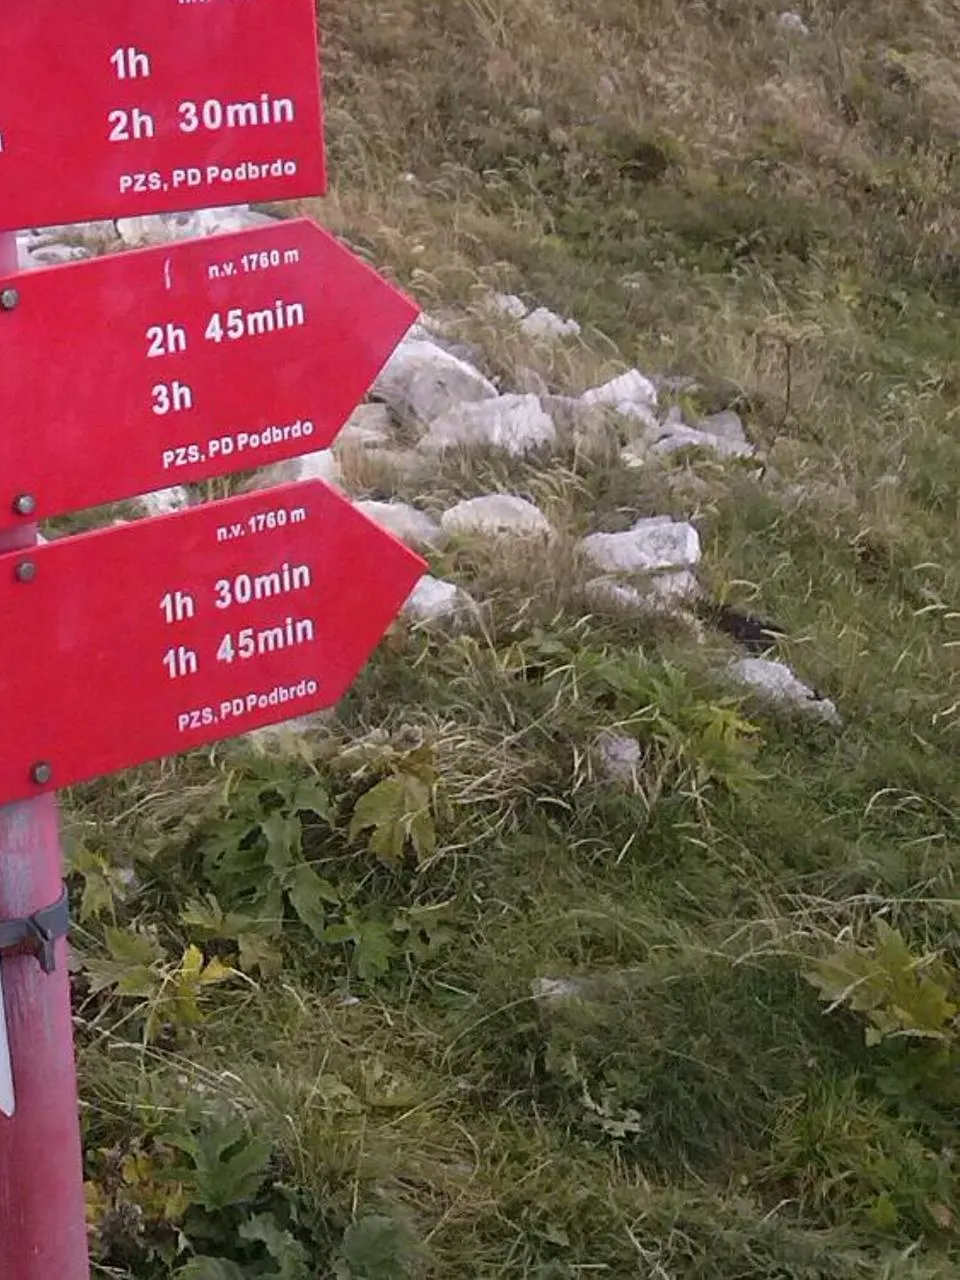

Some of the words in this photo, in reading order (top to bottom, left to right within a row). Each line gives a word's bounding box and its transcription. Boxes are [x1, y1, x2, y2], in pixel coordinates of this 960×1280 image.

[110, 47, 150, 80] 1h
[108, 107, 154, 142] 2h
[178, 93, 294, 133] 30min
[172, 167, 202, 188] PD
[206, 158, 297, 184] Podbrdo
[208, 261, 238, 280] n.v.
[240, 251, 280, 272] 1760
[283, 248, 300, 264] m
[145, 323, 187, 358] 2h
[204, 300, 304, 343] 45min
[151, 380, 192, 415] 3h
[208, 436, 234, 458] PD
[236, 419, 314, 451] Podbrdo
[216, 523, 246, 542] n.v.
[247, 511, 287, 533] 1760
[290, 507, 306, 523] m
[159, 591, 194, 623] 1h
[214, 562, 311, 609] 30min
[162, 646, 198, 679] 1h
[216, 616, 314, 663] 45min
[219, 698, 245, 720] PD
[245, 679, 317, 712] Podbrdo
